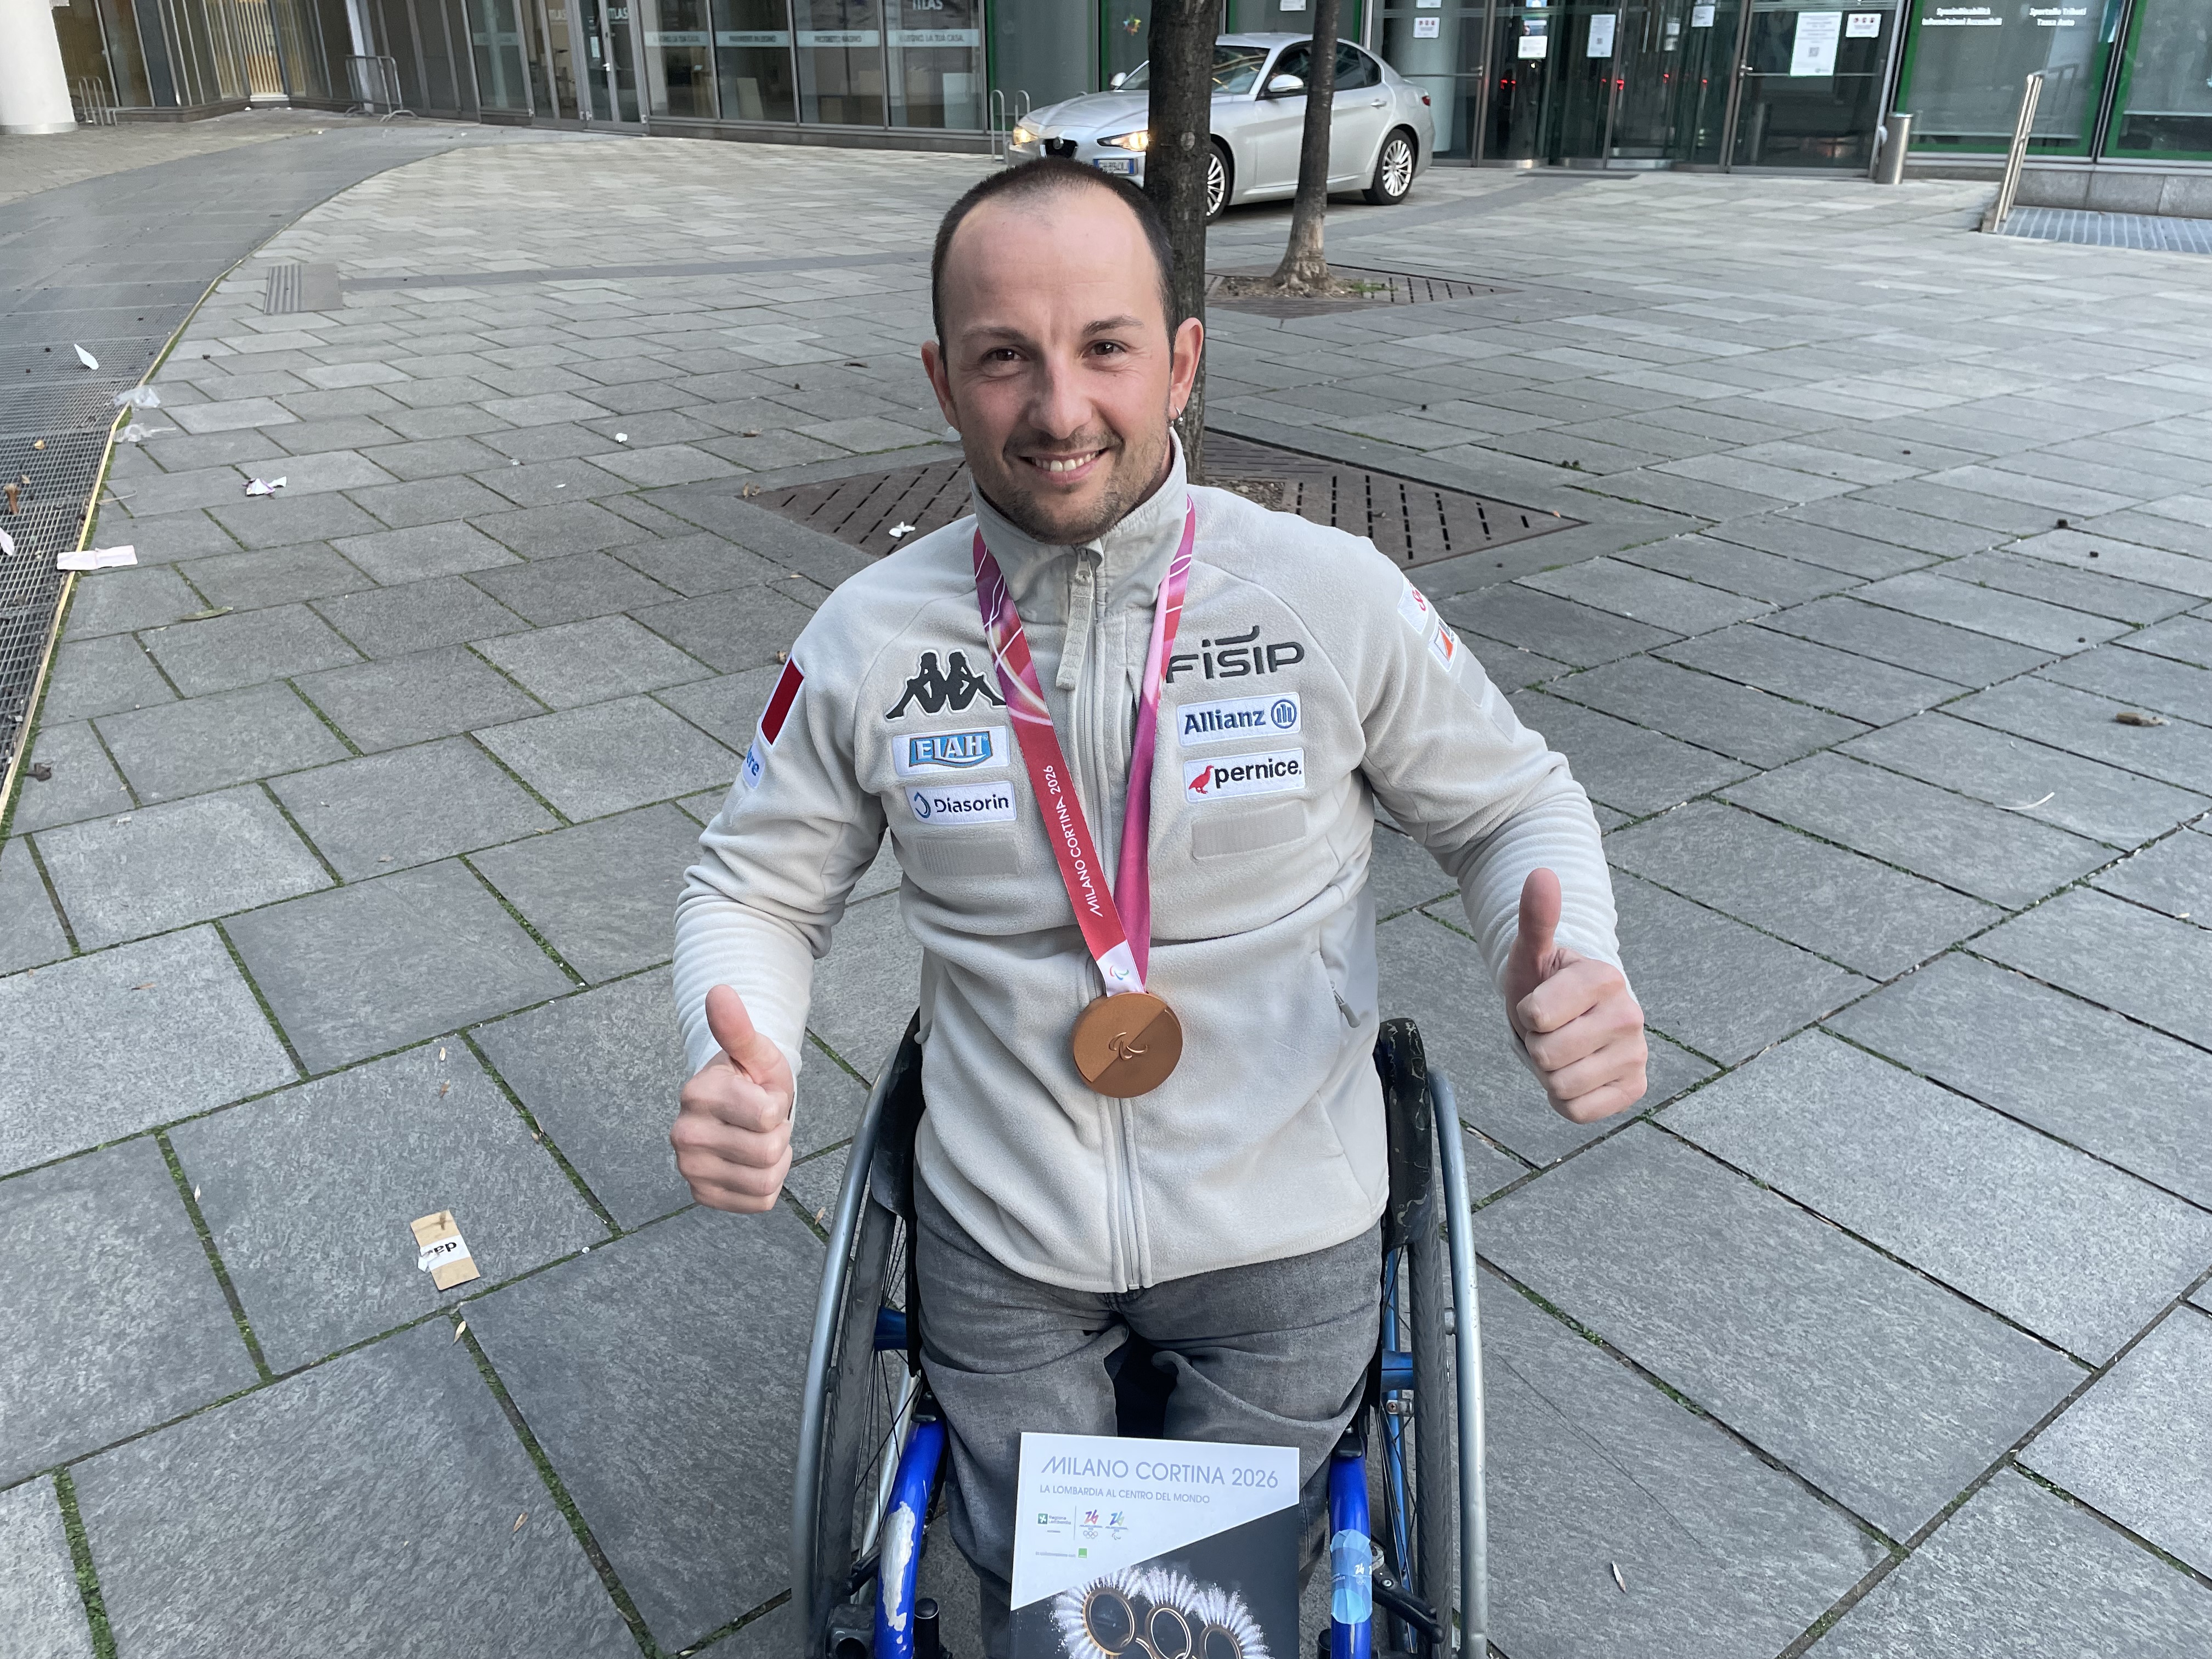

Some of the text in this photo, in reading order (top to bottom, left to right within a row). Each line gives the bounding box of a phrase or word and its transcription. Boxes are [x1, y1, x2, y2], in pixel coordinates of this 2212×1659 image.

[1184, 709, 1266, 735] Allianz
[915, 735, 983, 760] ELAH
[934, 794, 1009, 813] Diasorin
[1043, 765, 1104, 917] MILANO CORTINA 2026
[1041, 1455, 1278, 1489] MILANO CORTINA 2026
[1040, 1485, 1210, 1504] LA LOMBARDIA AL CENTRO DEL MONDO
